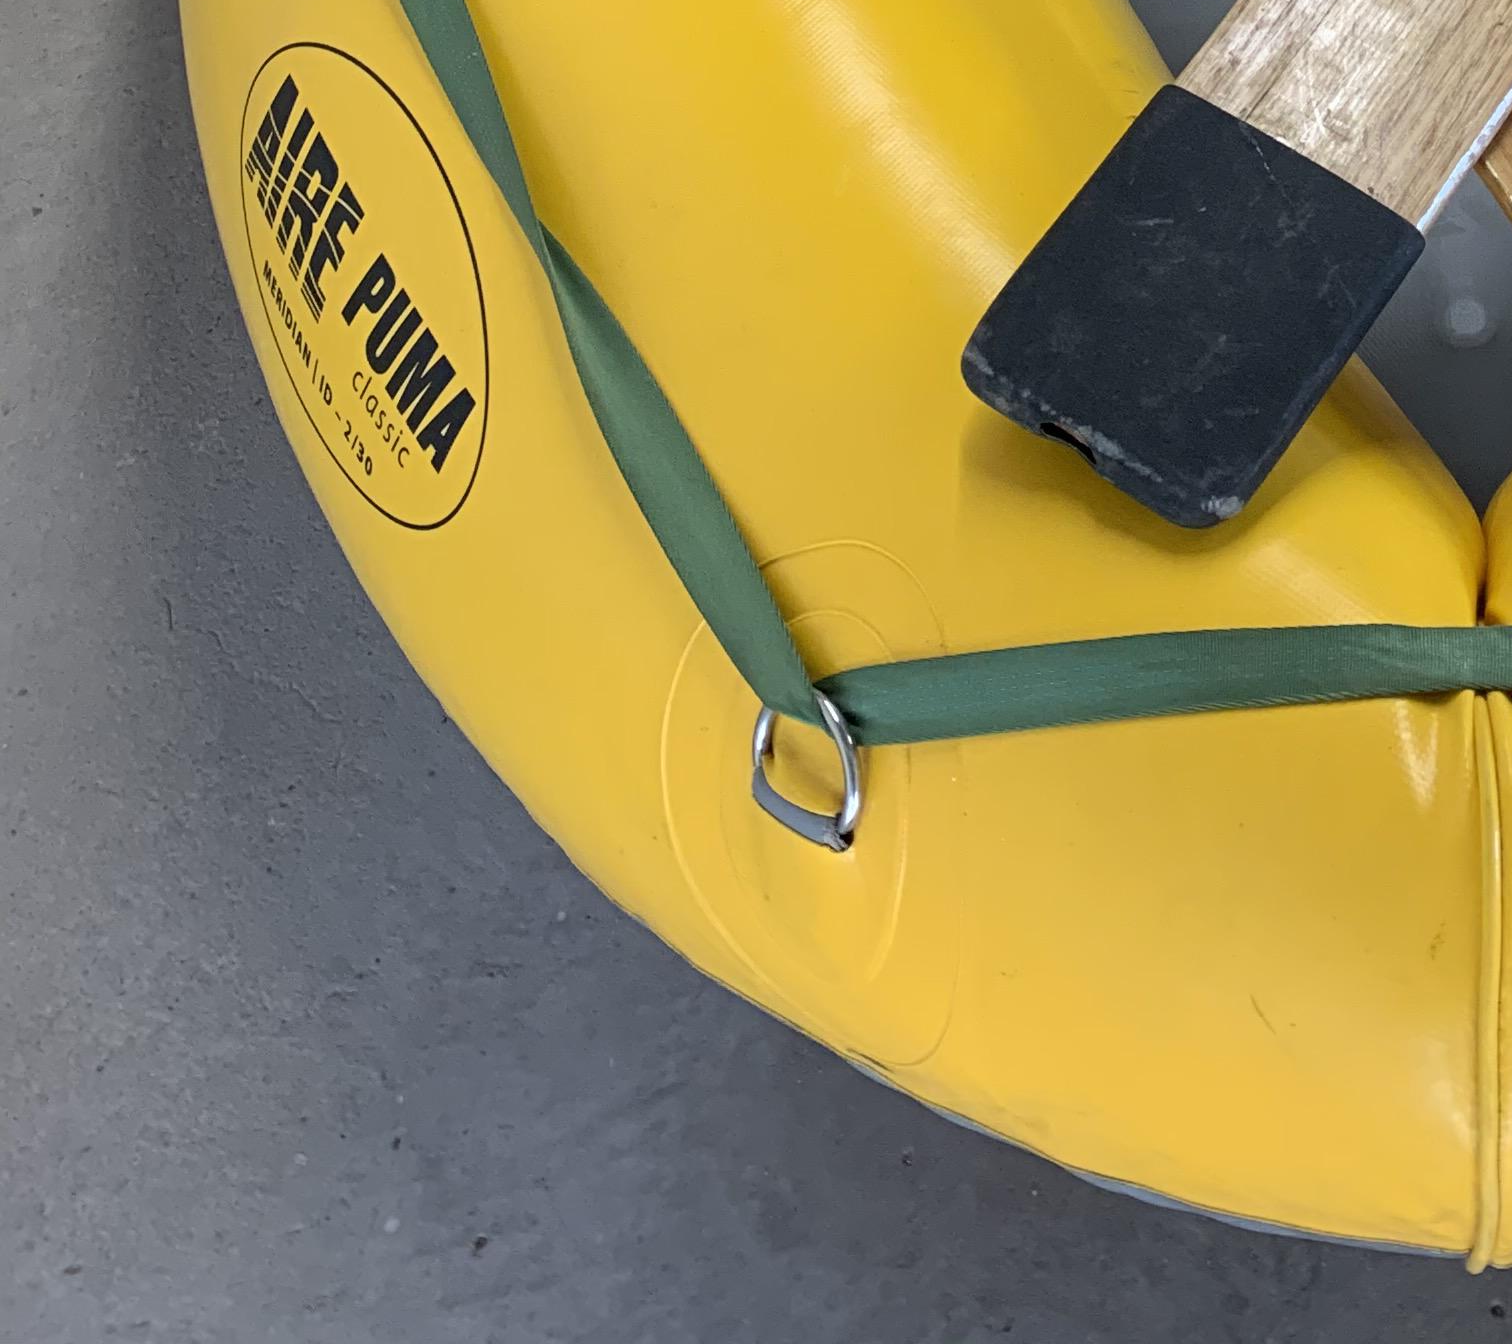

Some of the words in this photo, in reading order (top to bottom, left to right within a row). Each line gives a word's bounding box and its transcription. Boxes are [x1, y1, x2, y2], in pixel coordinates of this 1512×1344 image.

[245, 73, 365, 324] AIRE
[341, 253, 476, 473] PUMA
[263, 260, 312, 368] MERIDIAN
[319, 375, 333, 406] ID
[352, 371, 410, 468] classic
